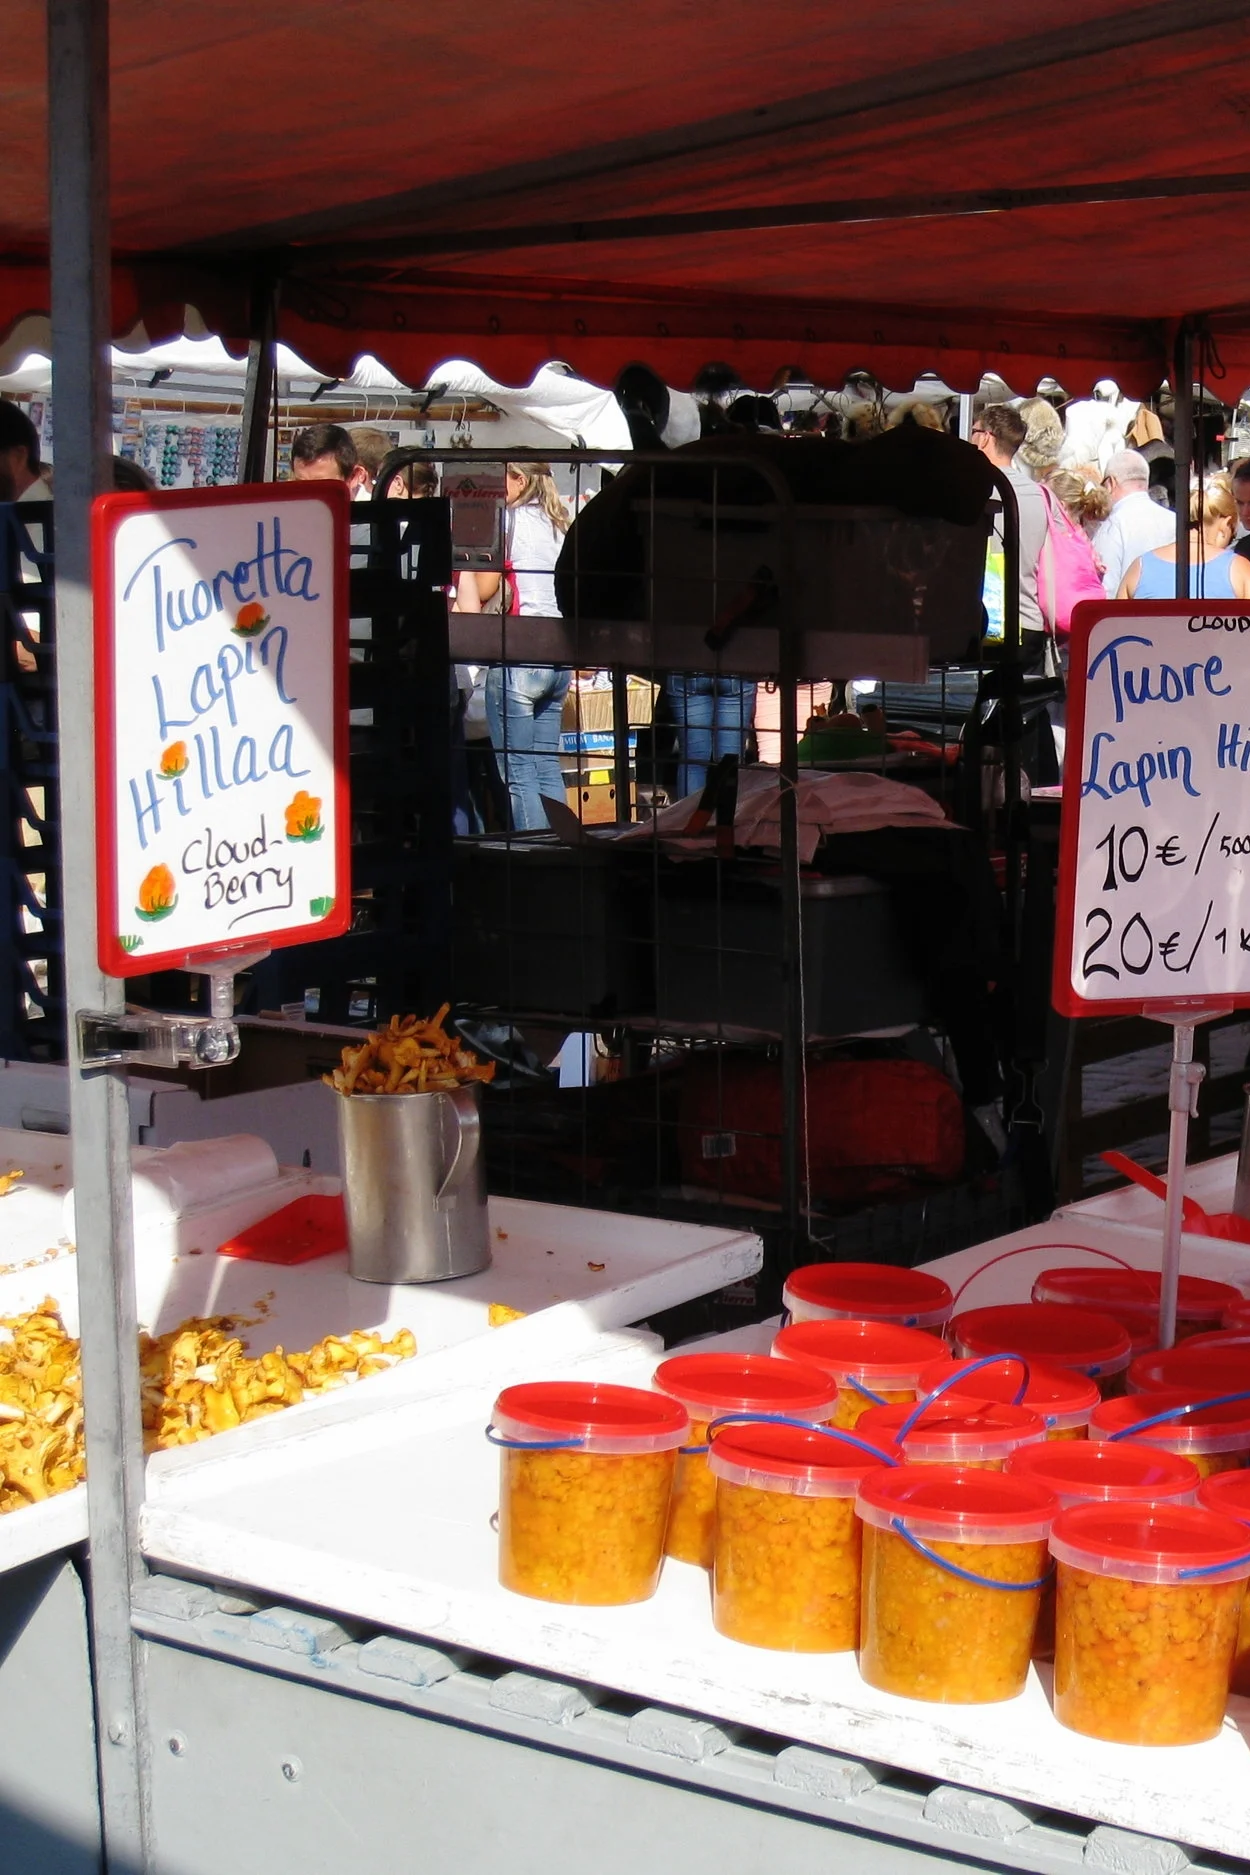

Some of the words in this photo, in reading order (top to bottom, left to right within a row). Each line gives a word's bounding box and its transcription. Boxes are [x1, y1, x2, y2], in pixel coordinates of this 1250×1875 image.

[123, 516, 320, 652] Tuoretta
[151, 625, 298, 741] Lapin
[1086, 634, 1232, 723] Tuore
[128, 724, 312, 850] Hillaa
[1080, 732, 1202, 807] Lapin
[204, 866, 294, 930] Berry
